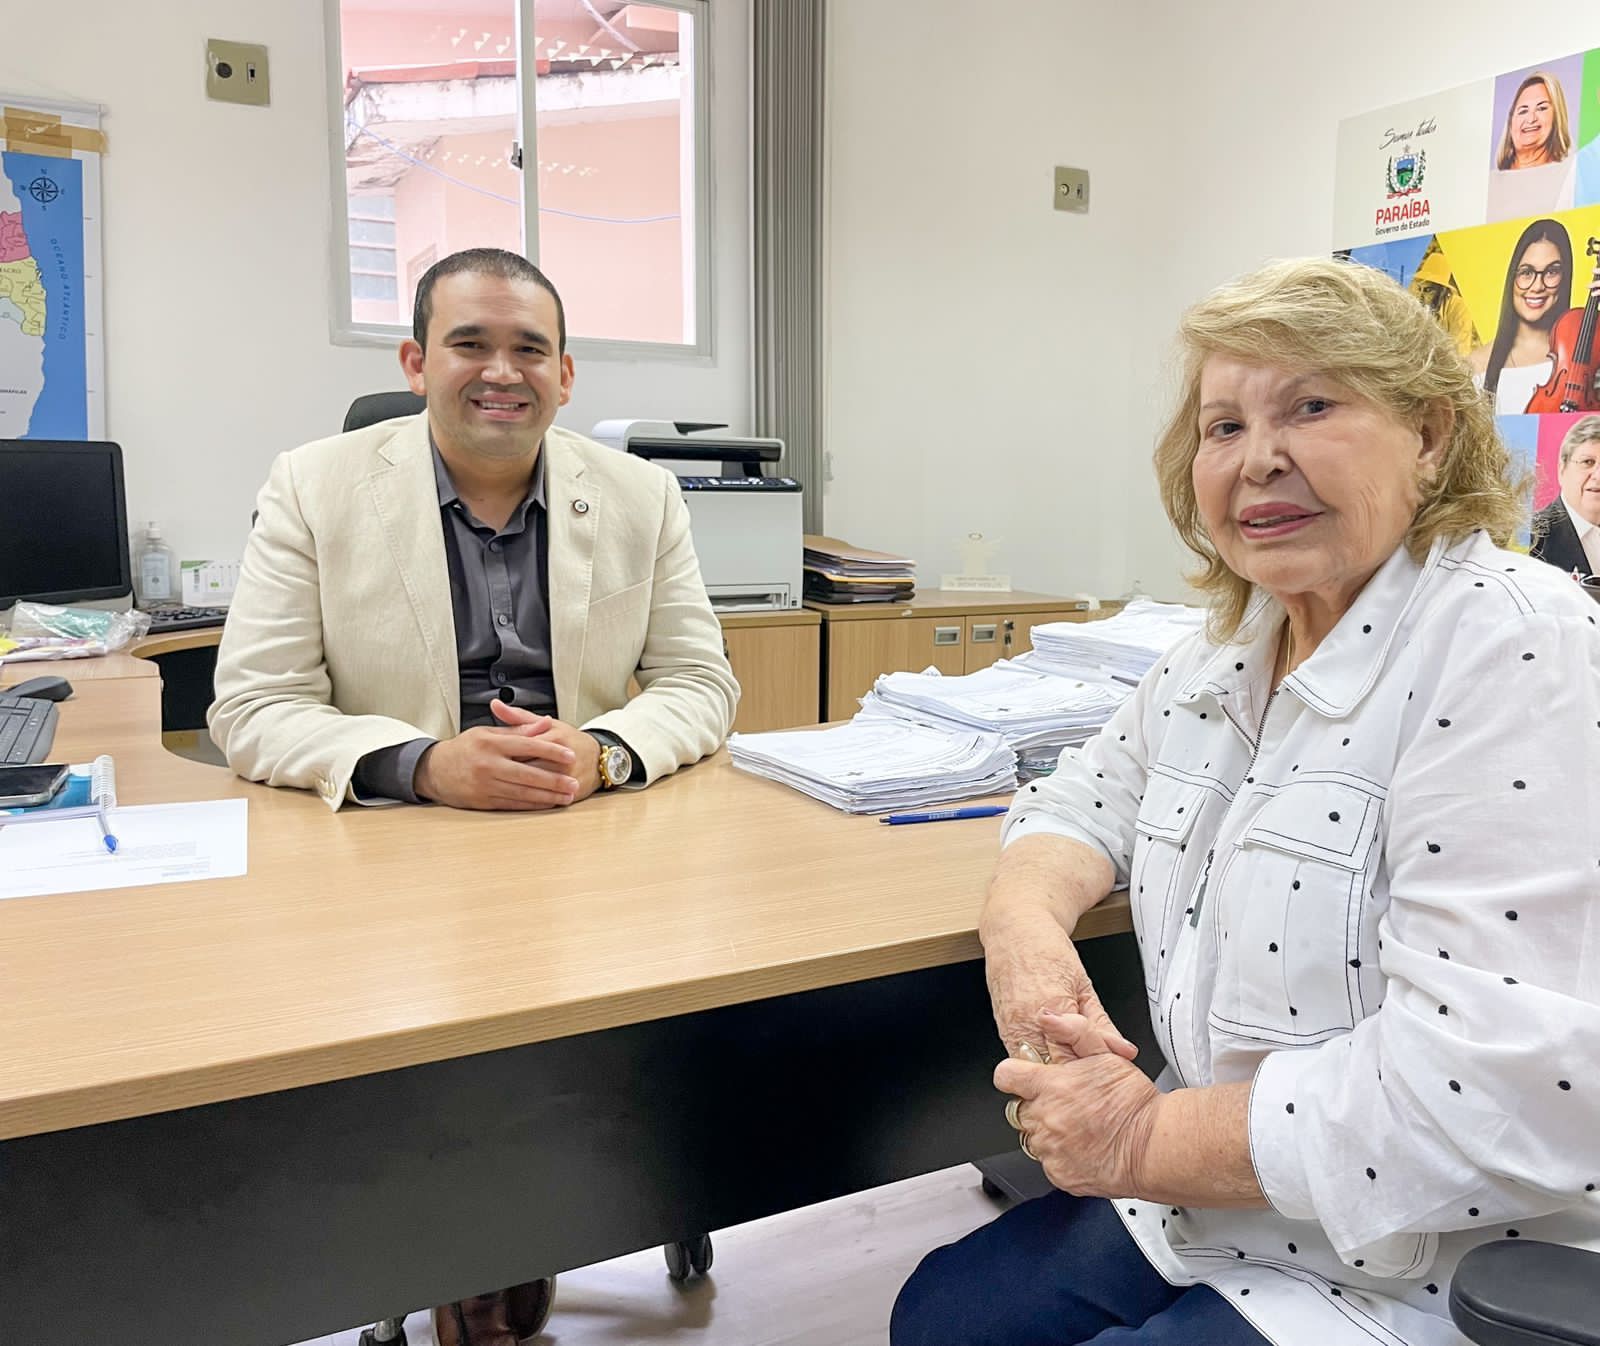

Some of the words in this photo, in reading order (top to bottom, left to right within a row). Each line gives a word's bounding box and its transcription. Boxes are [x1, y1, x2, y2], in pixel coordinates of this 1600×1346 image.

[1376, 199, 1430, 225] PARAÍBA
[1375, 225, 1399, 236] Governo
[1409, 219, 1430, 229] Estado
[50, 238, 69, 280] OCEANO
